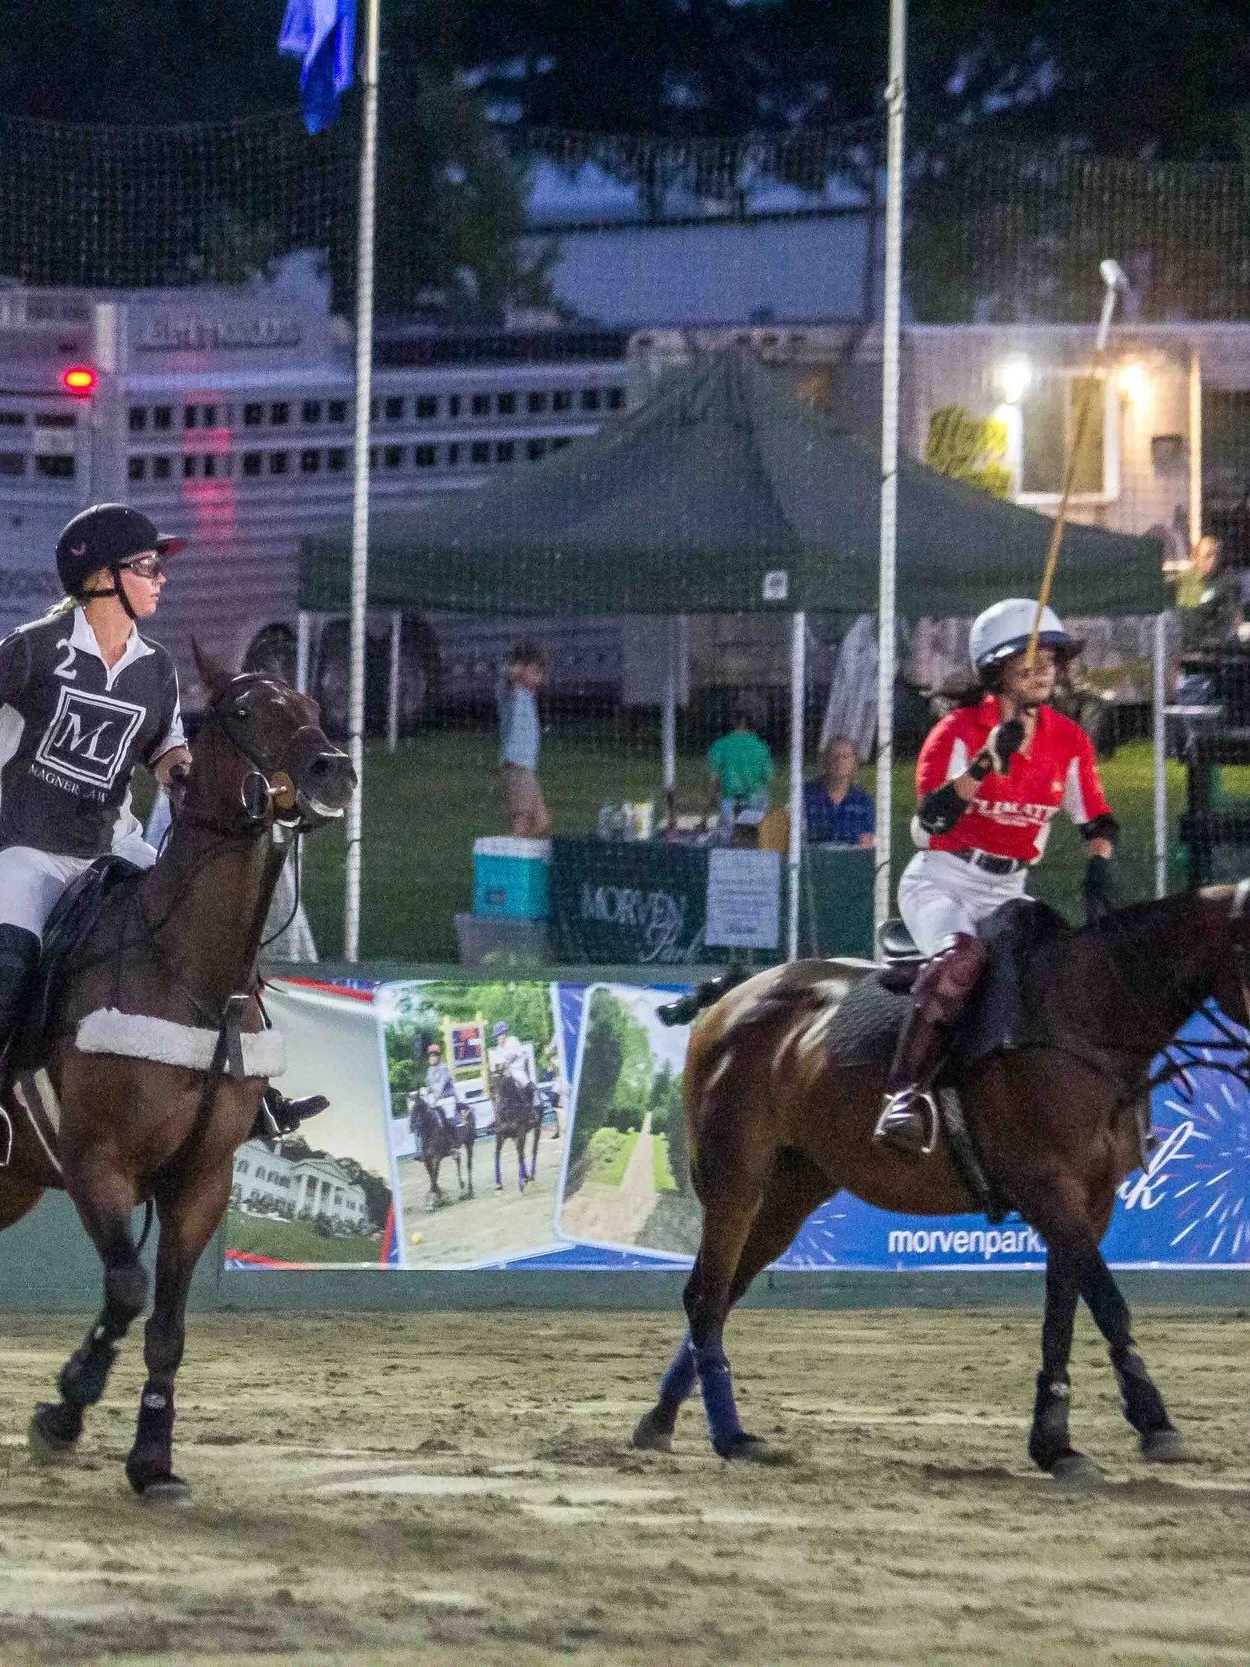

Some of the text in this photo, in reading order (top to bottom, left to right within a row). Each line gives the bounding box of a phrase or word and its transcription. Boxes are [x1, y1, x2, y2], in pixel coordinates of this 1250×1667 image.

[53, 638, 77, 680] 2
[53, 711, 116, 765] ML
[888, 1225, 1046, 1260] morvenpark.
